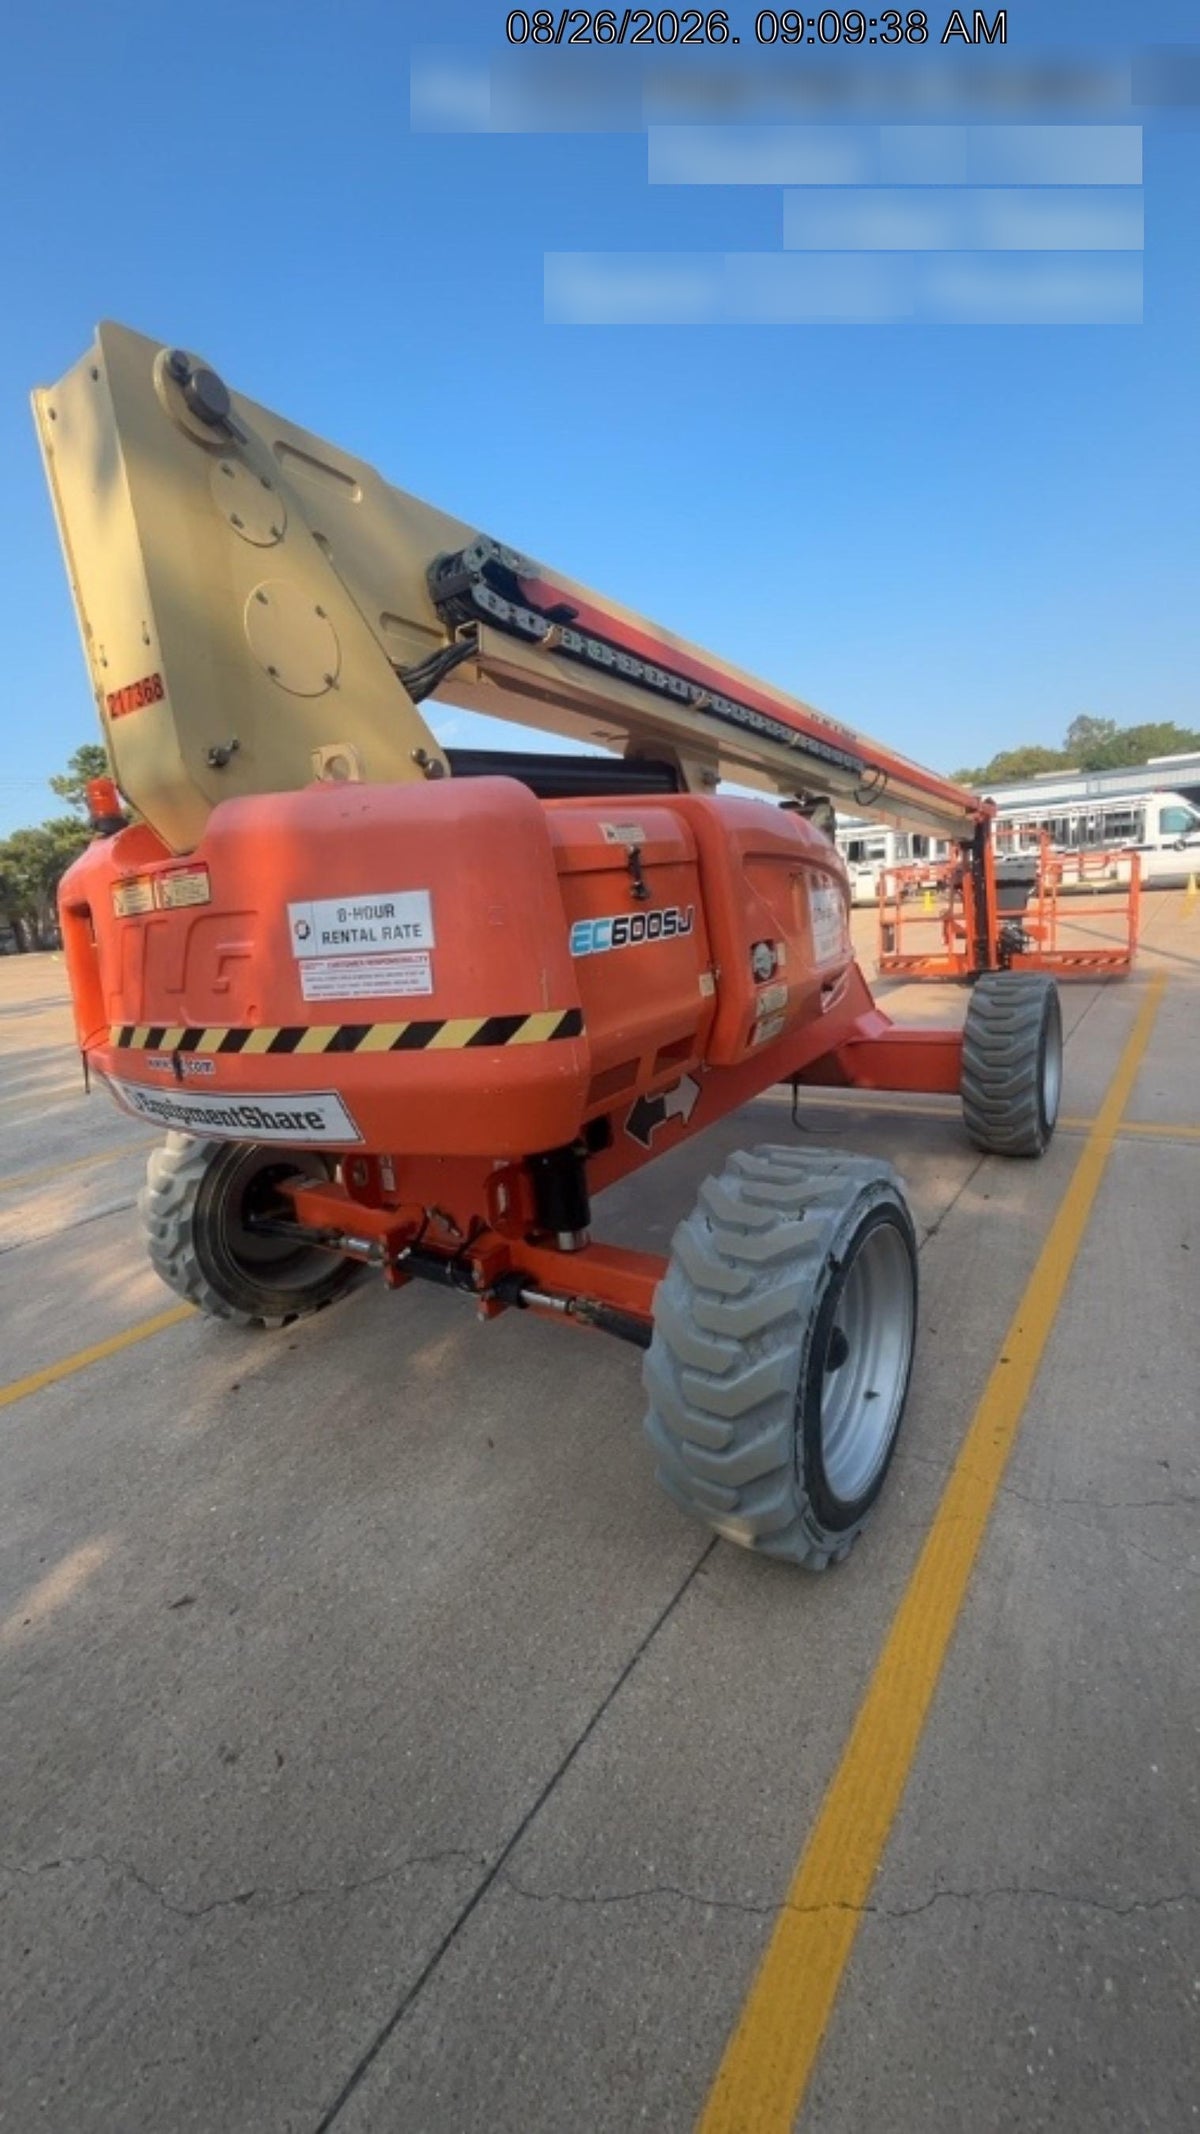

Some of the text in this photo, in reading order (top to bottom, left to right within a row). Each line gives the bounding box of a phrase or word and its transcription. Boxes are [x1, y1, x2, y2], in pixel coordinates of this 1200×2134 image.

[321, 924, 423, 945] RENTAL RATE
[569, 905, 694, 956] EC600SJ
